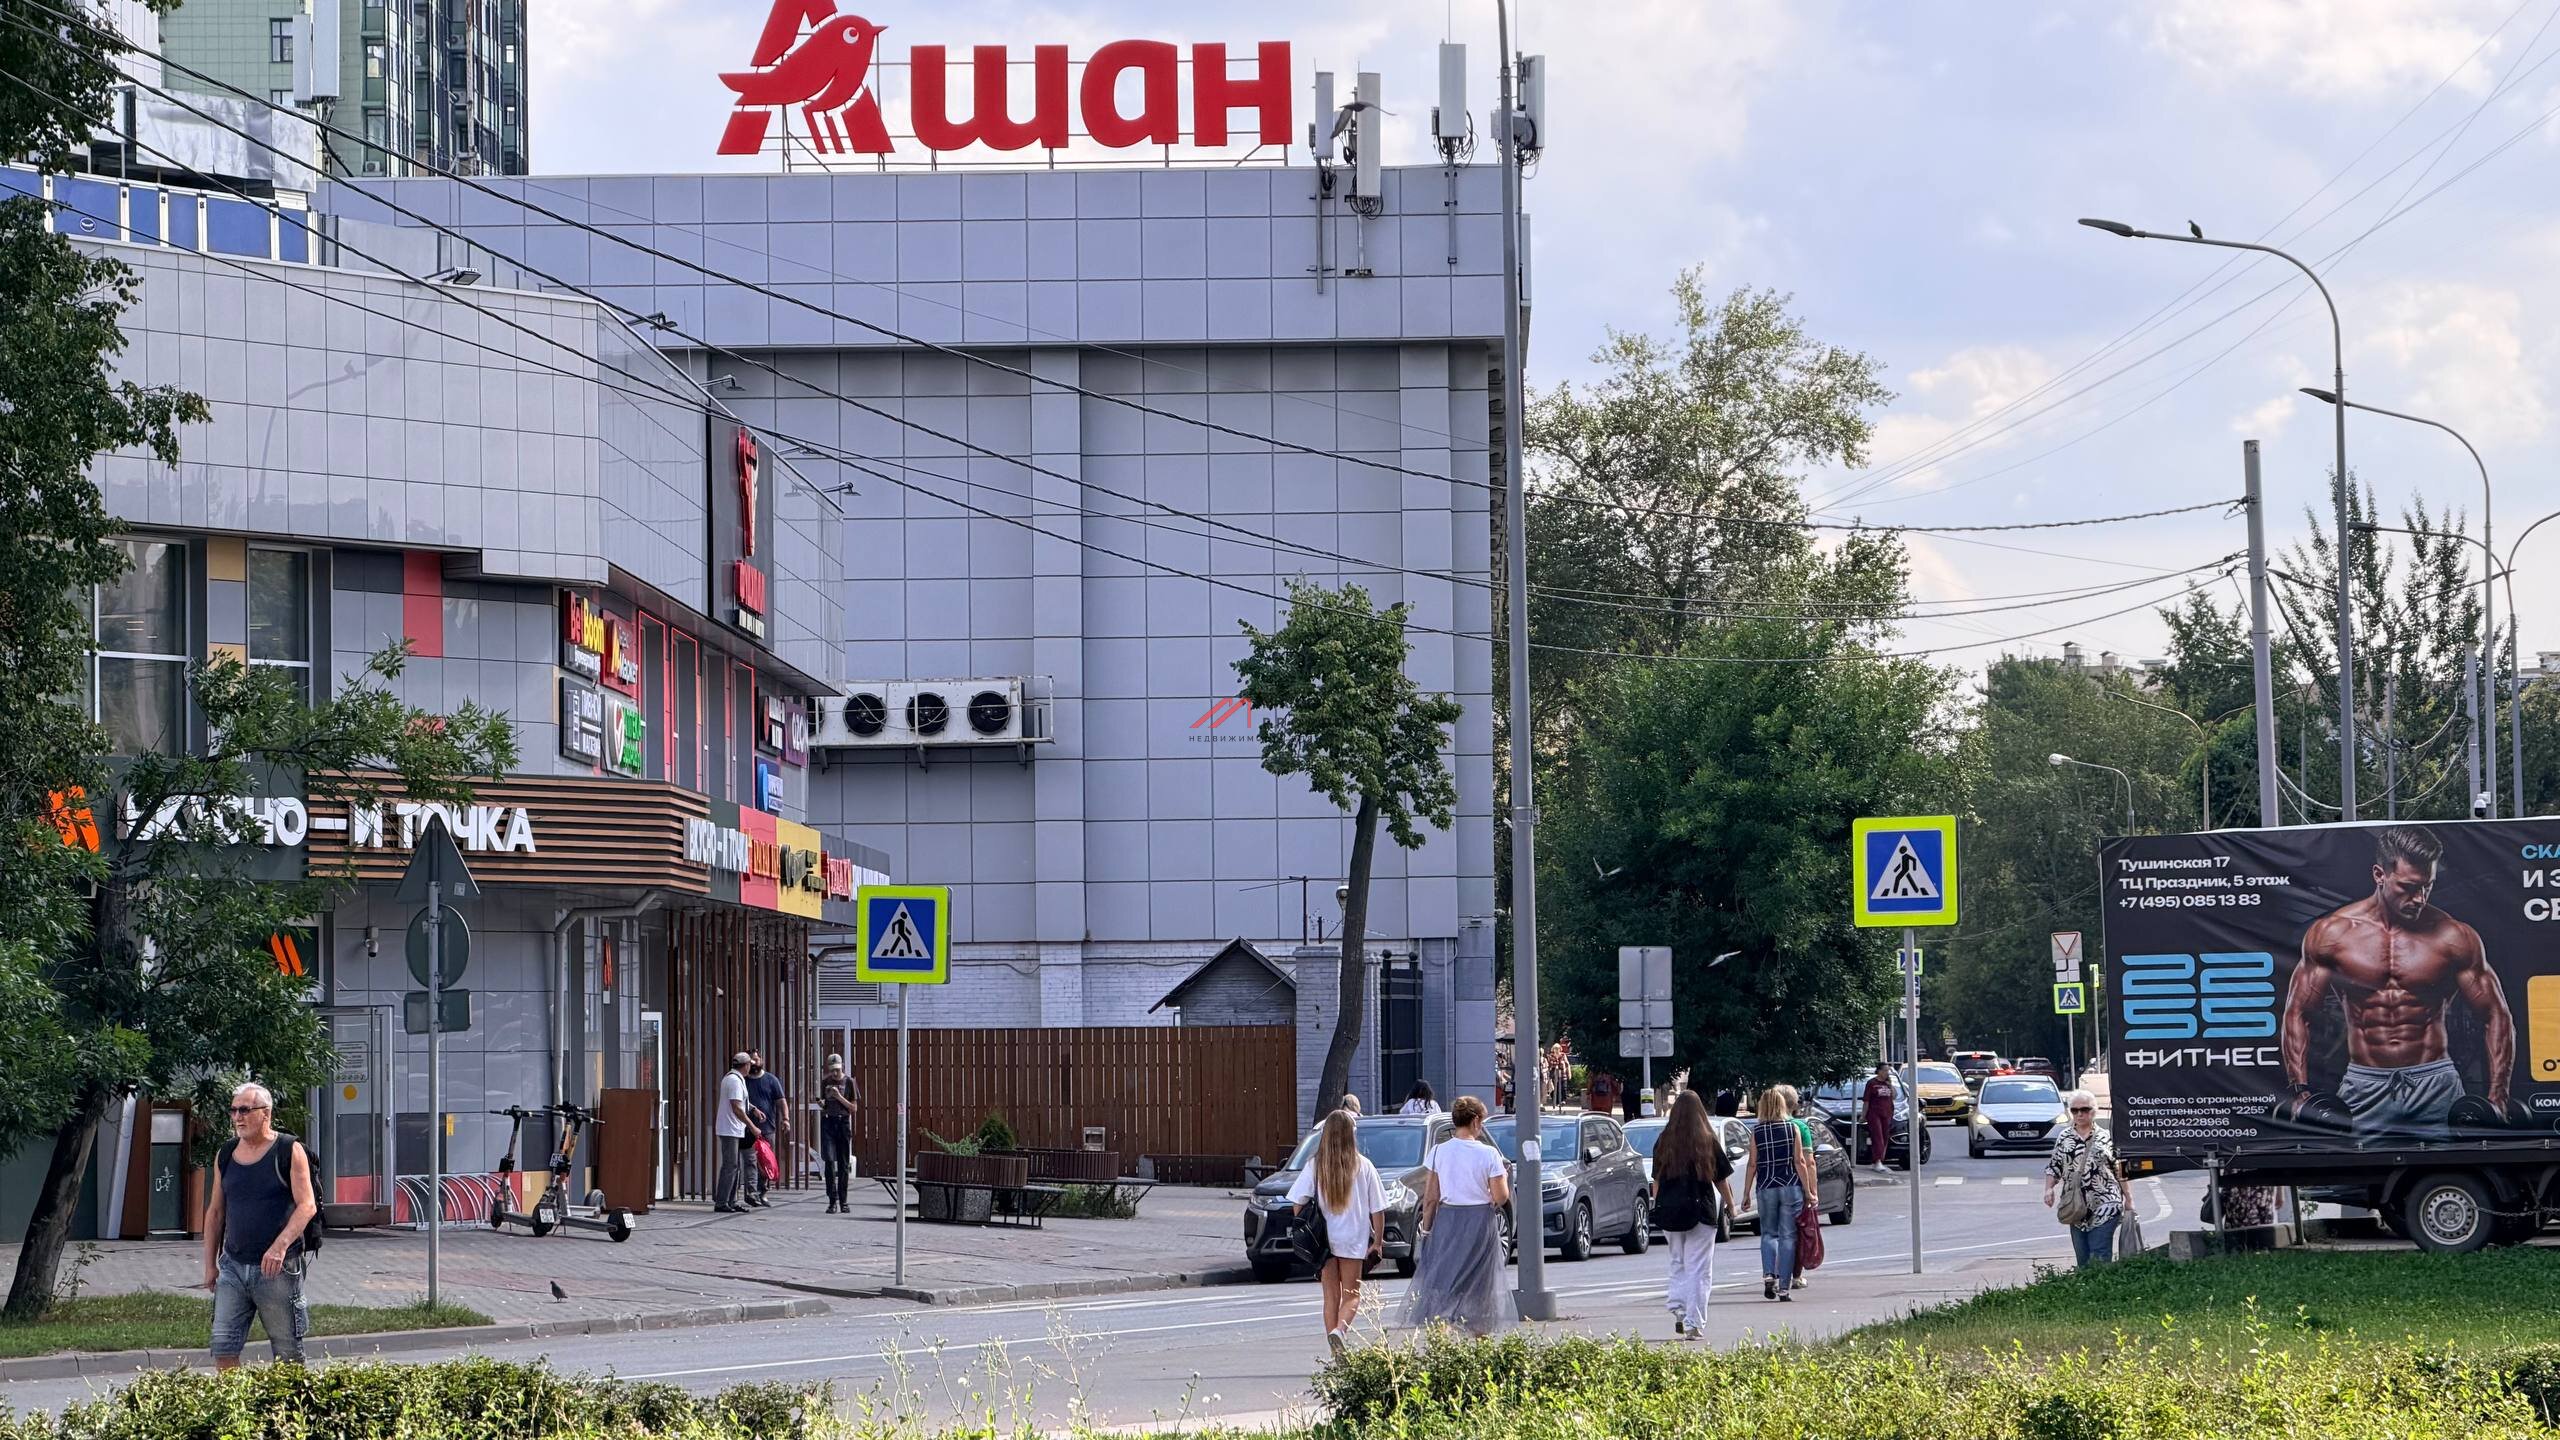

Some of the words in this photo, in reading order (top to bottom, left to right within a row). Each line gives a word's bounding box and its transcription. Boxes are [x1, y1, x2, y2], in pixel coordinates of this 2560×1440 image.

[2118, 857, 2212, 872] Тушинская
[2213, 856, 2231, 868] 17
[2118, 878, 2143, 891] ТЦ
[2145, 876, 2232, 891] Праздник,
[2233, 875, 2244, 887] 5
[2246, 875, 2291, 887] этаж
[2523, 869, 2544, 889] И
[2119, 897, 2138, 909] +7
[2139, 895, 2181, 909] (495)
[2182, 894, 2216, 907] 085
[2217, 894, 2236, 906] 13
[2238, 893, 2261, 906] 83
[2125, 1047, 2280, 1069] ФИТНЕС
[2128, 1096, 2186, 1105] Общество
[2187, 1096, 2195, 1104] с
[2196, 1094, 2277, 1105] ограниченной
[2128, 1107, 2231, 1116] ответственностью
[2232, 1105, 2269, 1115] "2255"
[2129, 1118, 2155, 1128] ИНН
[2156, 1117, 2230, 1127] 5024228966
[2129, 1130, 2160, 1139] ОГРН
